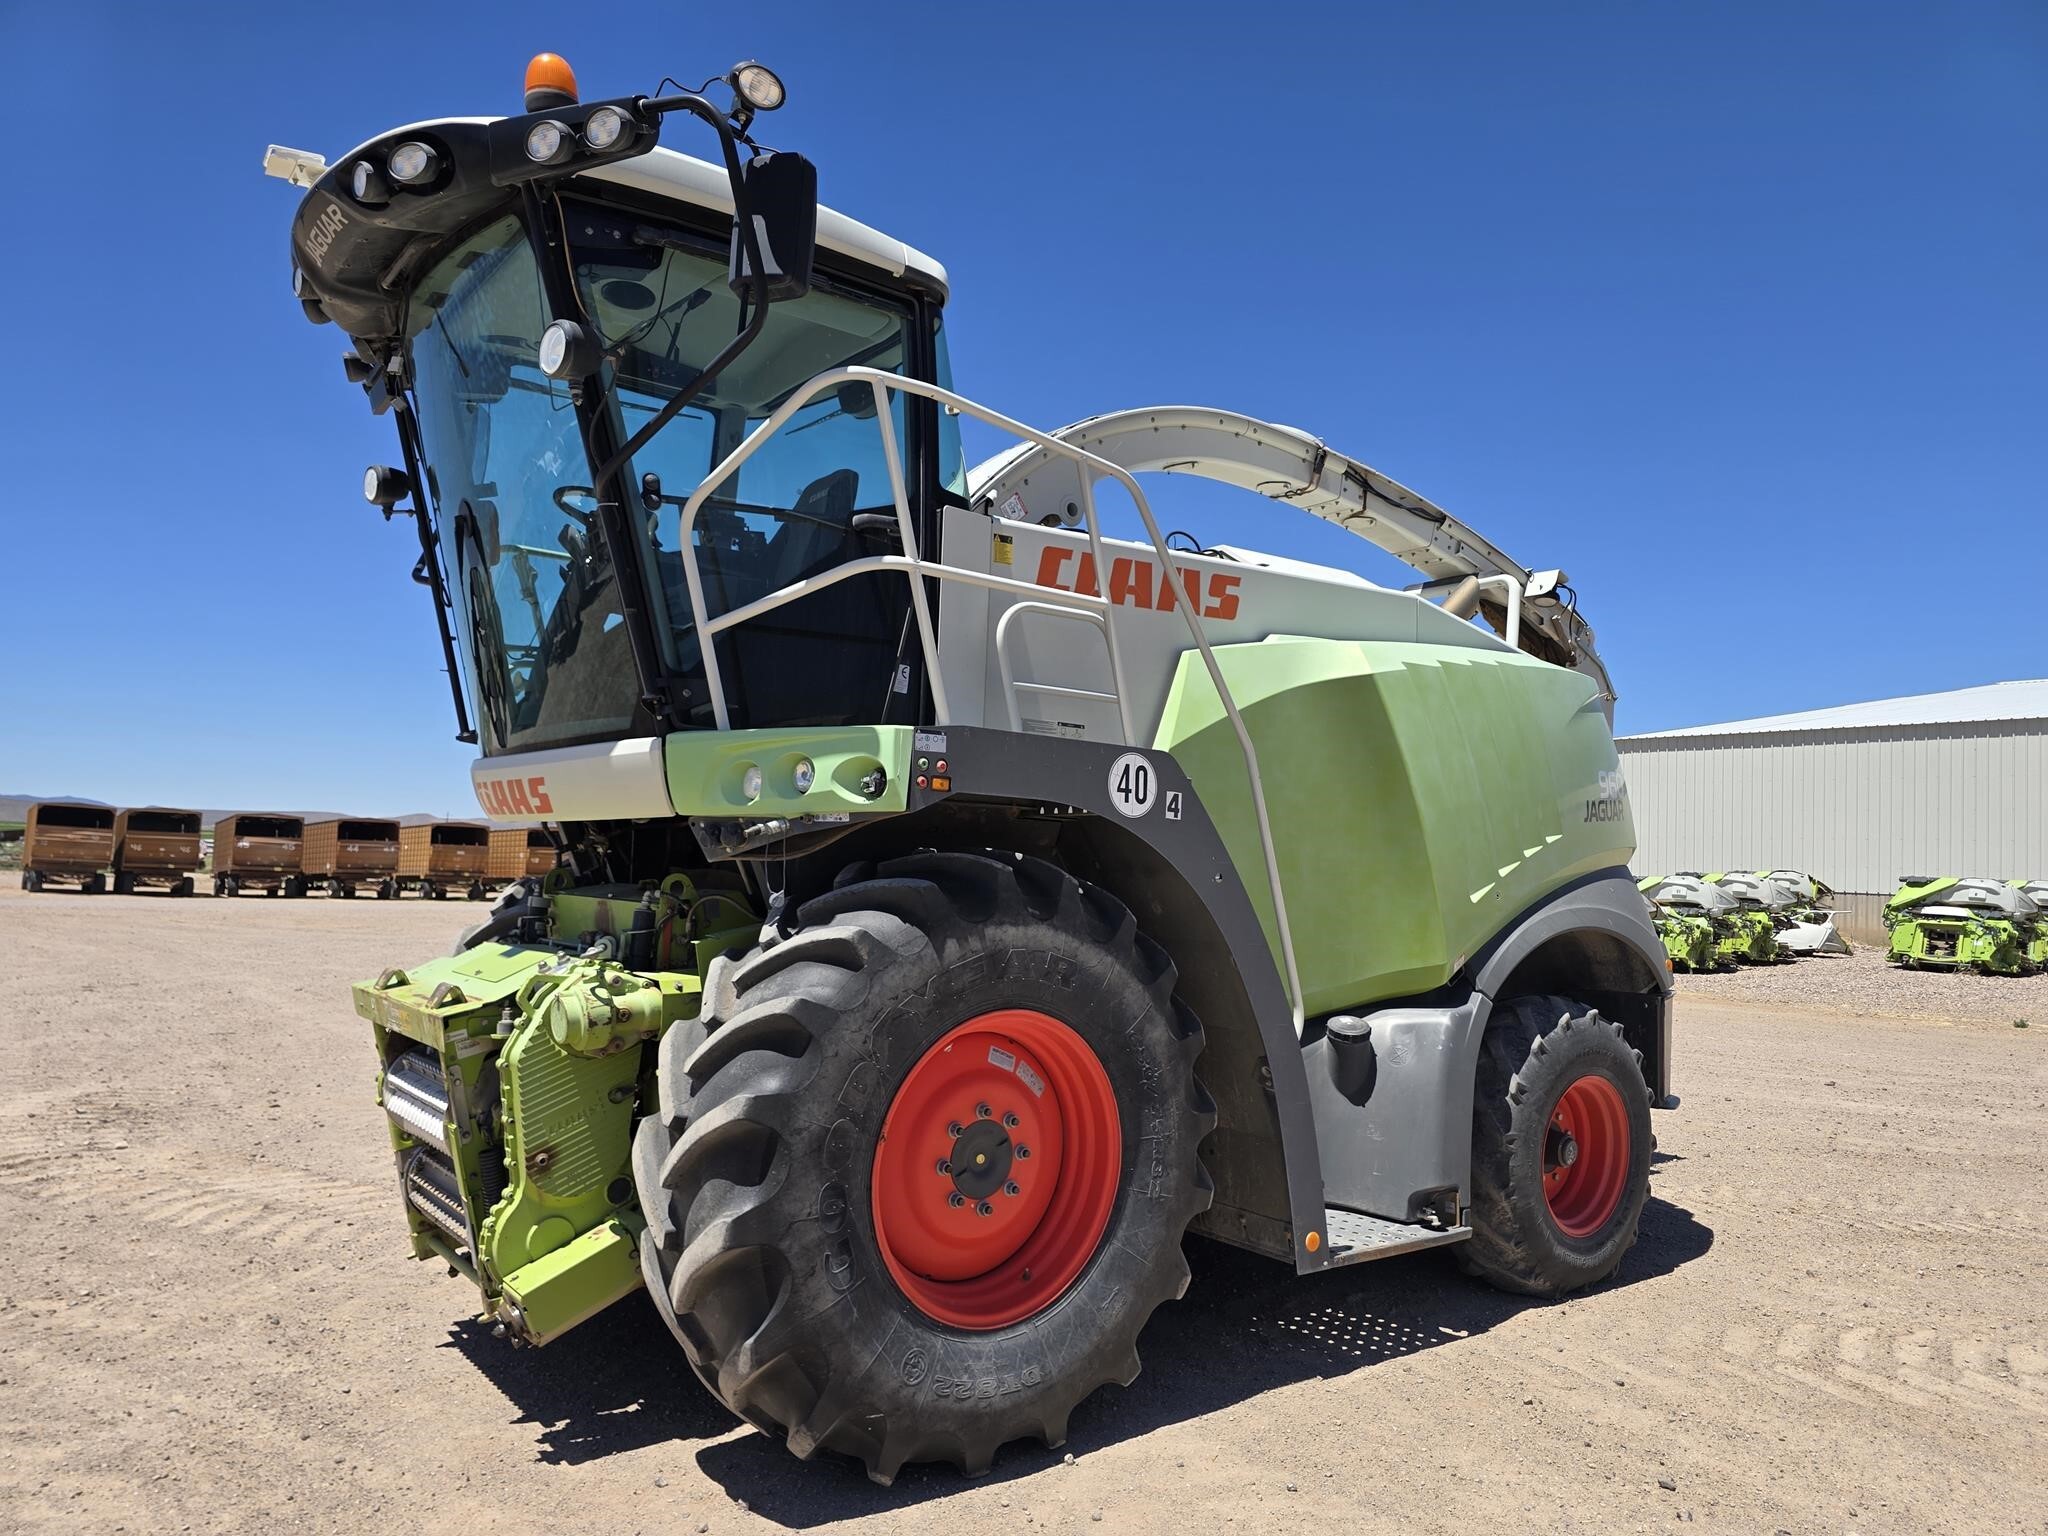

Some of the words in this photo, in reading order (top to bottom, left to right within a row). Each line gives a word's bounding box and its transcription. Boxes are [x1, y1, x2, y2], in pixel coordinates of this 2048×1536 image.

[305, 203, 349, 268] JAGUAR
[1036, 545, 1242, 621] CLAAS
[476, 776, 554, 816] CLAAS
[1116, 763, 1148, 805] 40
[1167, 793, 1180, 819] 4
[1583, 799, 1625, 823] JAGUAR
[932, 1364, 1042, 1400] DT822
